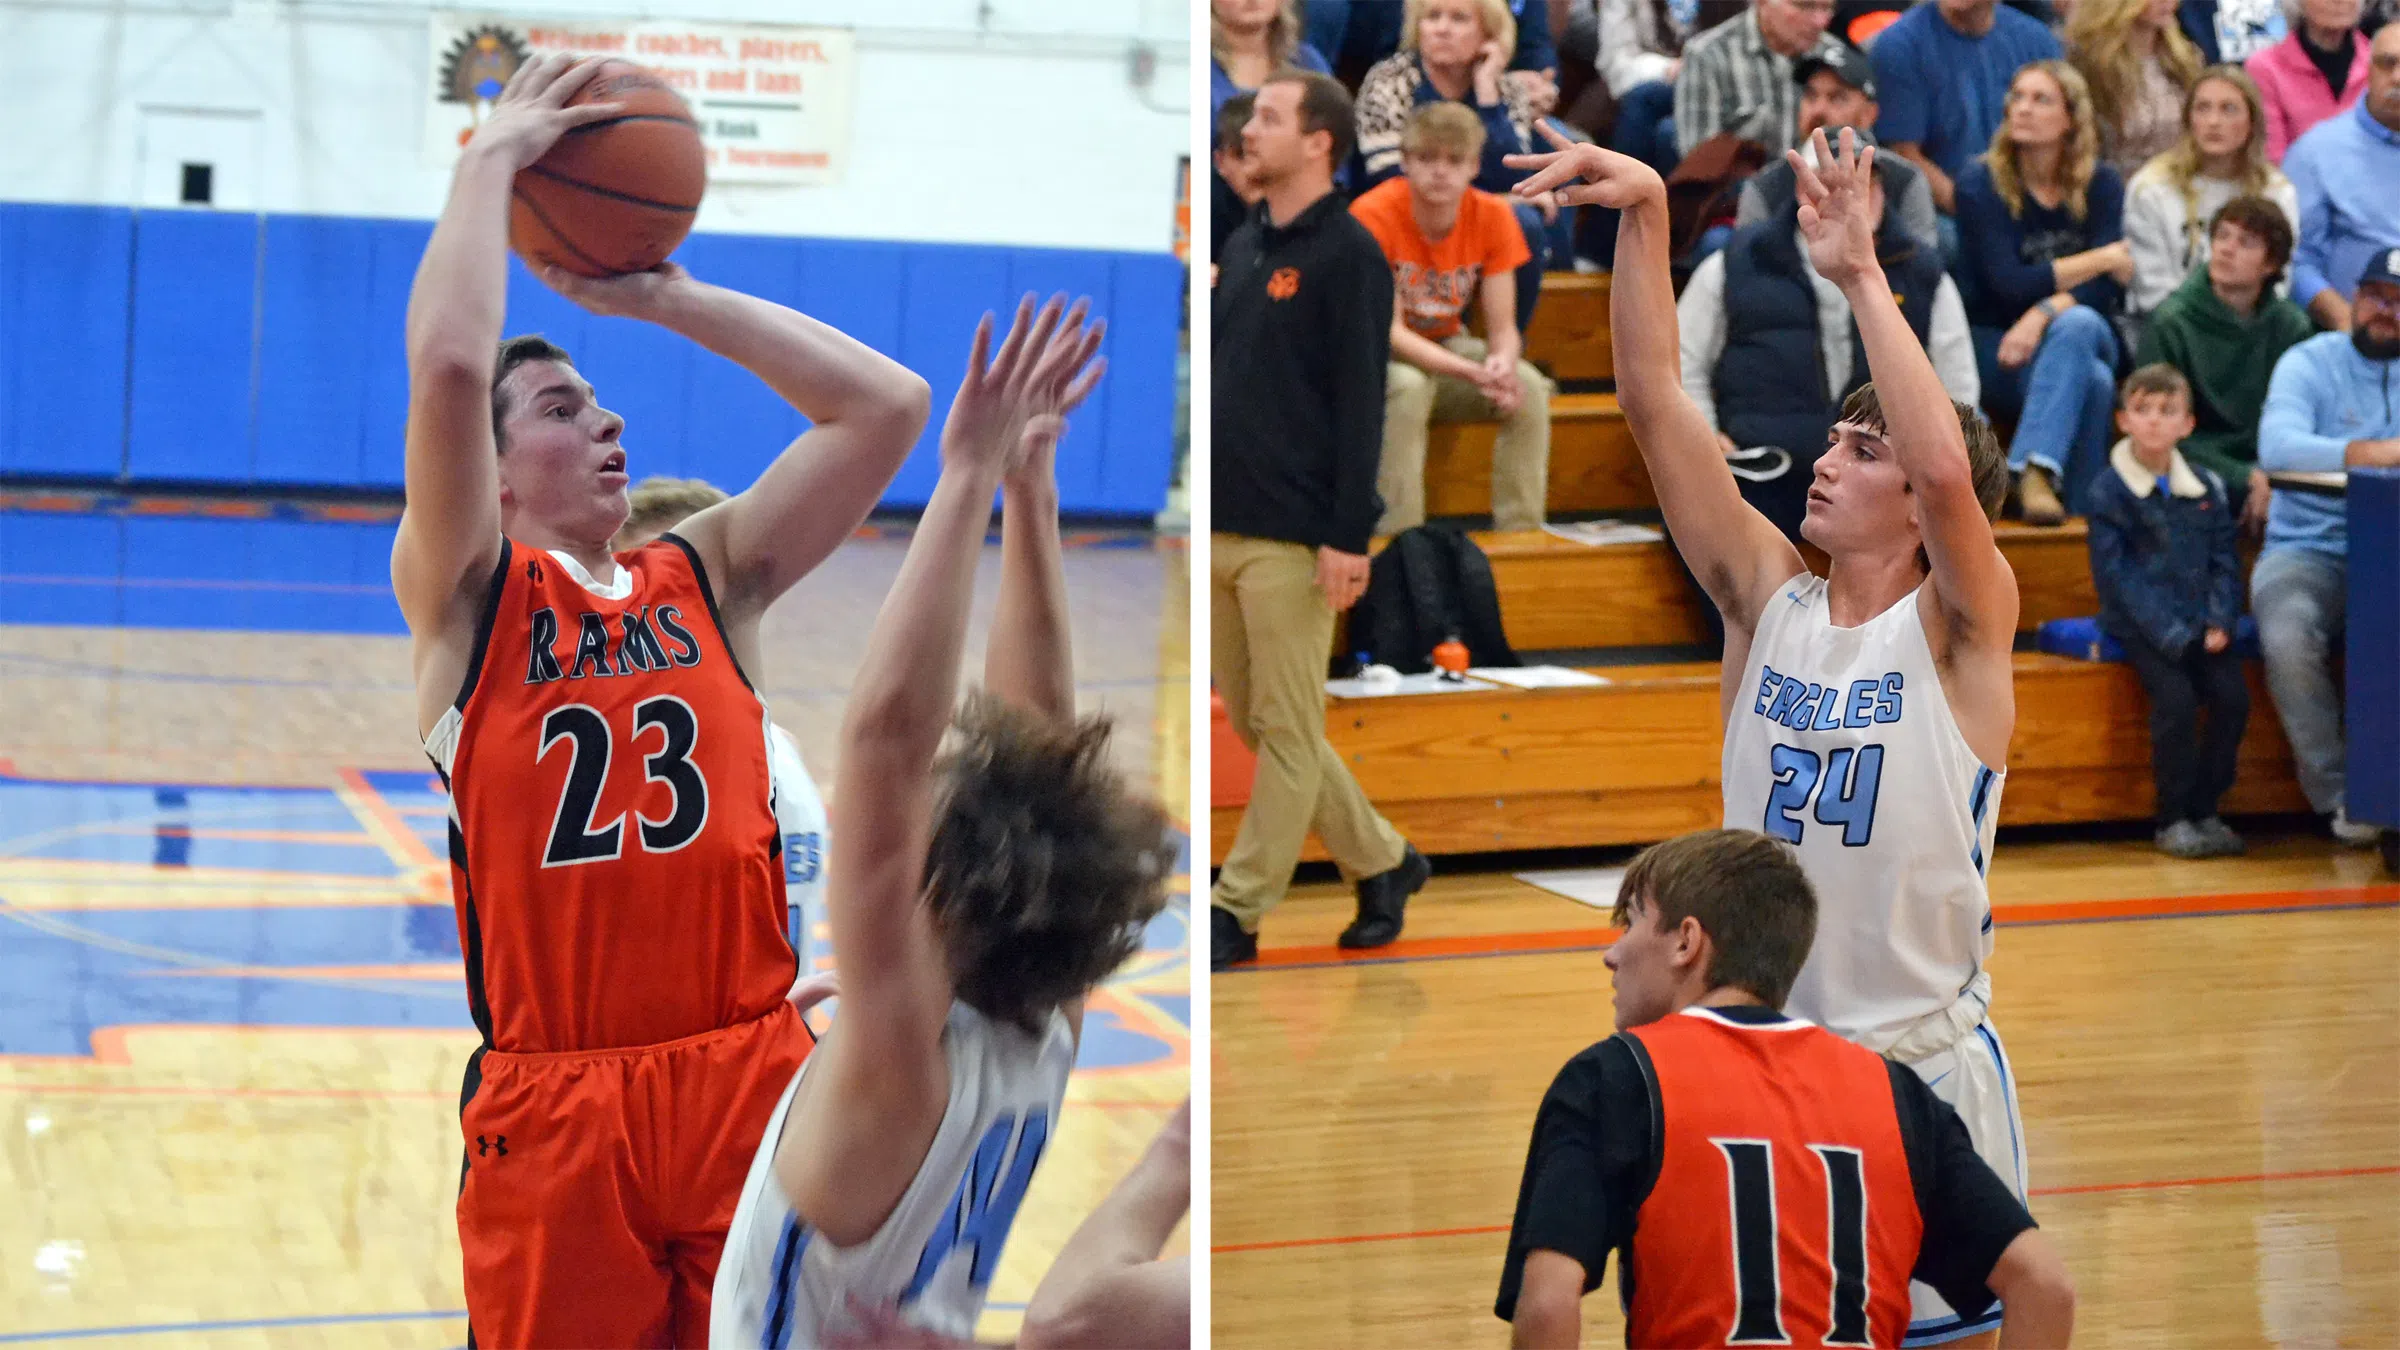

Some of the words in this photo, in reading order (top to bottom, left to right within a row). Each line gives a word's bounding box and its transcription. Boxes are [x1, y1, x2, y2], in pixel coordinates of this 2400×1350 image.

[528, 27, 627, 50] Welcome
[635, 33, 730, 59] coaches,
[739, 37, 829, 64] players,
[705, 67, 747, 91] and
[715, 119, 759, 139] Bank
[726, 147, 830, 169] Tournament
[524, 604, 701, 685] RAMS
[1754, 664, 1904, 731] EAGLES
[536, 694, 709, 869] 23
[1764, 743, 1885, 847] 24
[1707, 1137, 1876, 1349] 11
